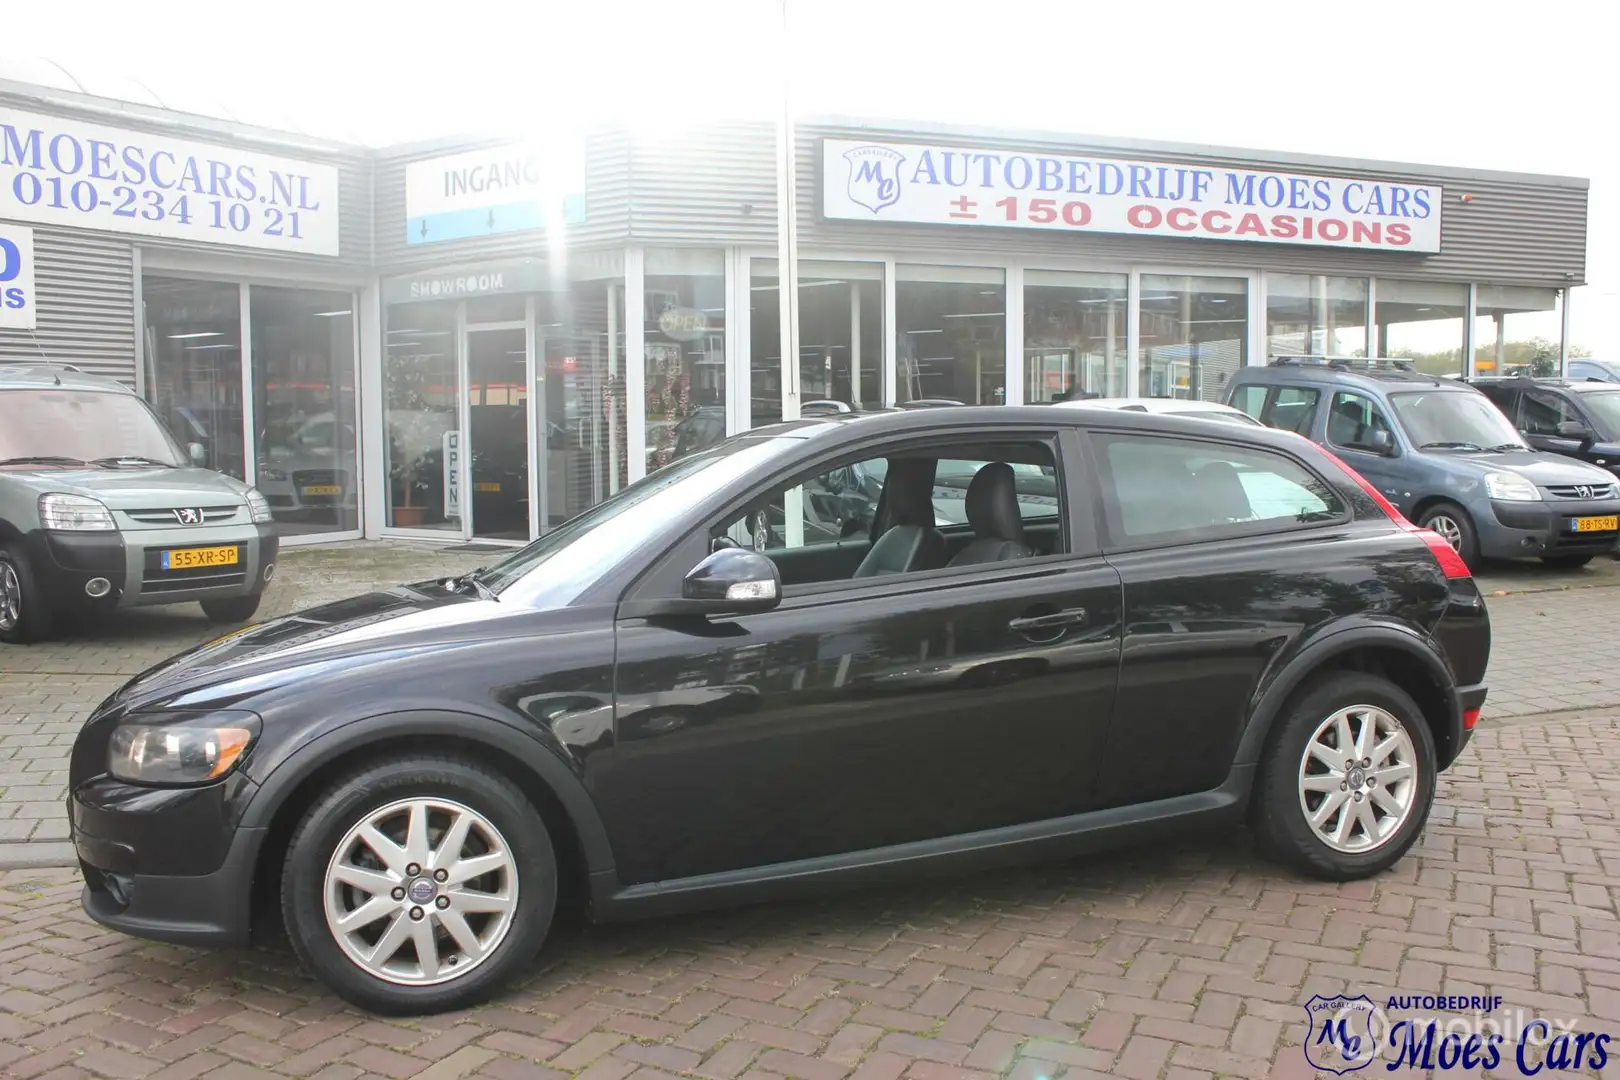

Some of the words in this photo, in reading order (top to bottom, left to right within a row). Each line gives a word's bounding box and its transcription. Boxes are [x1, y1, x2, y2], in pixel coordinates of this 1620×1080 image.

[1, 124, 320, 212] MOESCARS.NL
[444, 156, 540, 197] INGANG
[910, 149, 1213, 202] AUTOBEDRIJF
[1225, 173, 1331, 212] MOES
[1342, 183, 1431, 219] CARS
[12, 171, 193, 225] 010-234
[208, 200, 251, 232] 10
[263, 207, 304, 239] 21
[995, 196, 1092, 226] 150
[1127, 204, 1412, 246] OCCASIONS
[410, 273, 504, 298] SHOWROOM
[448, 433, 458, 503] OPEN
[175, 549, 235, 566] 55-XR-SP
